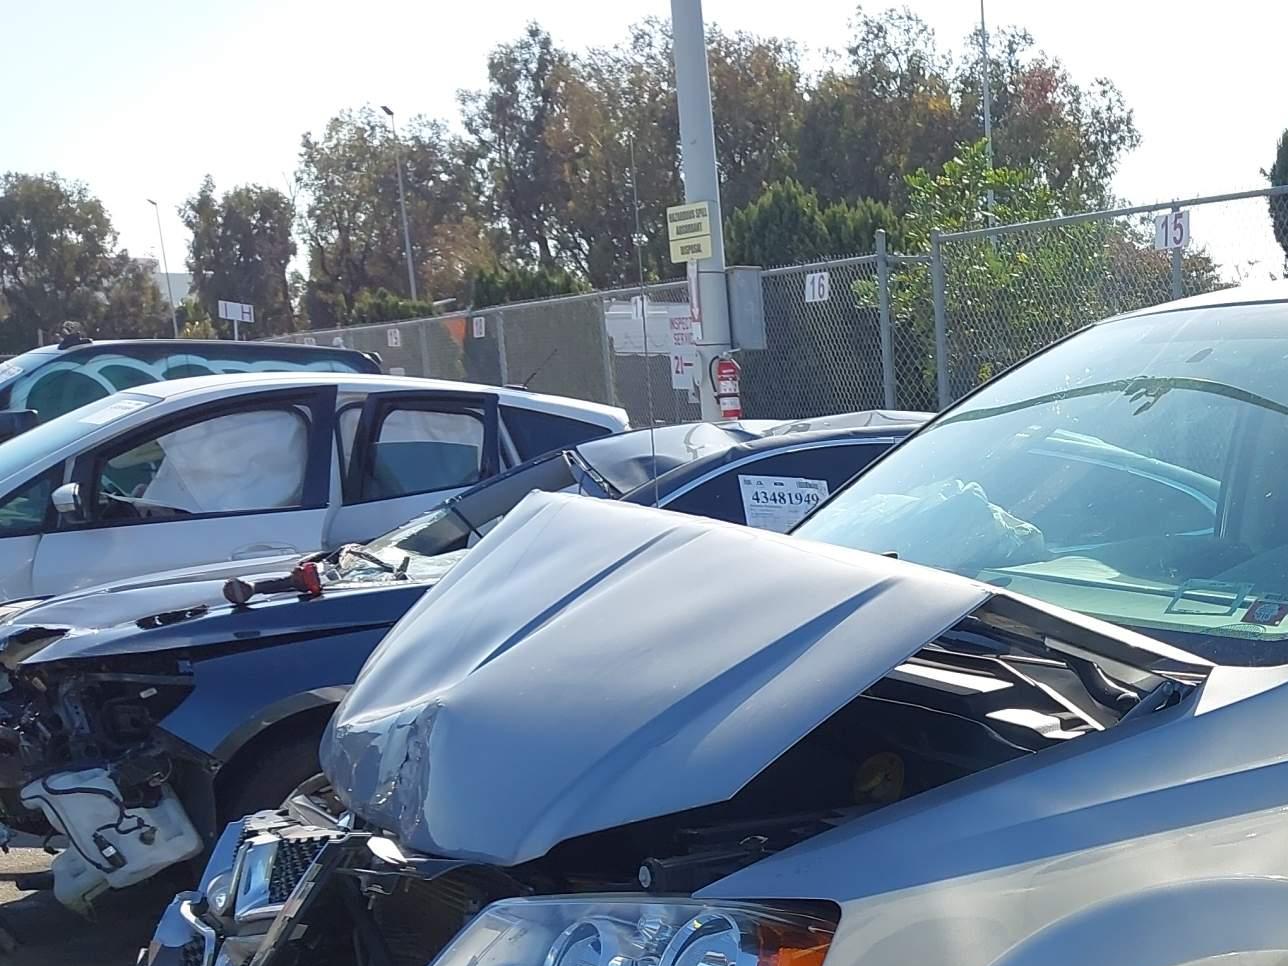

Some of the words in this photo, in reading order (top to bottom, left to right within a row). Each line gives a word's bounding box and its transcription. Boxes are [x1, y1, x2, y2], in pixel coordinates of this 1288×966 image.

[1161, 212, 1184, 246] 15
[680, 243, 702, 256] DISPOSAL
[810, 274, 825, 299] 16
[752, 491, 820, 505] 43481949
